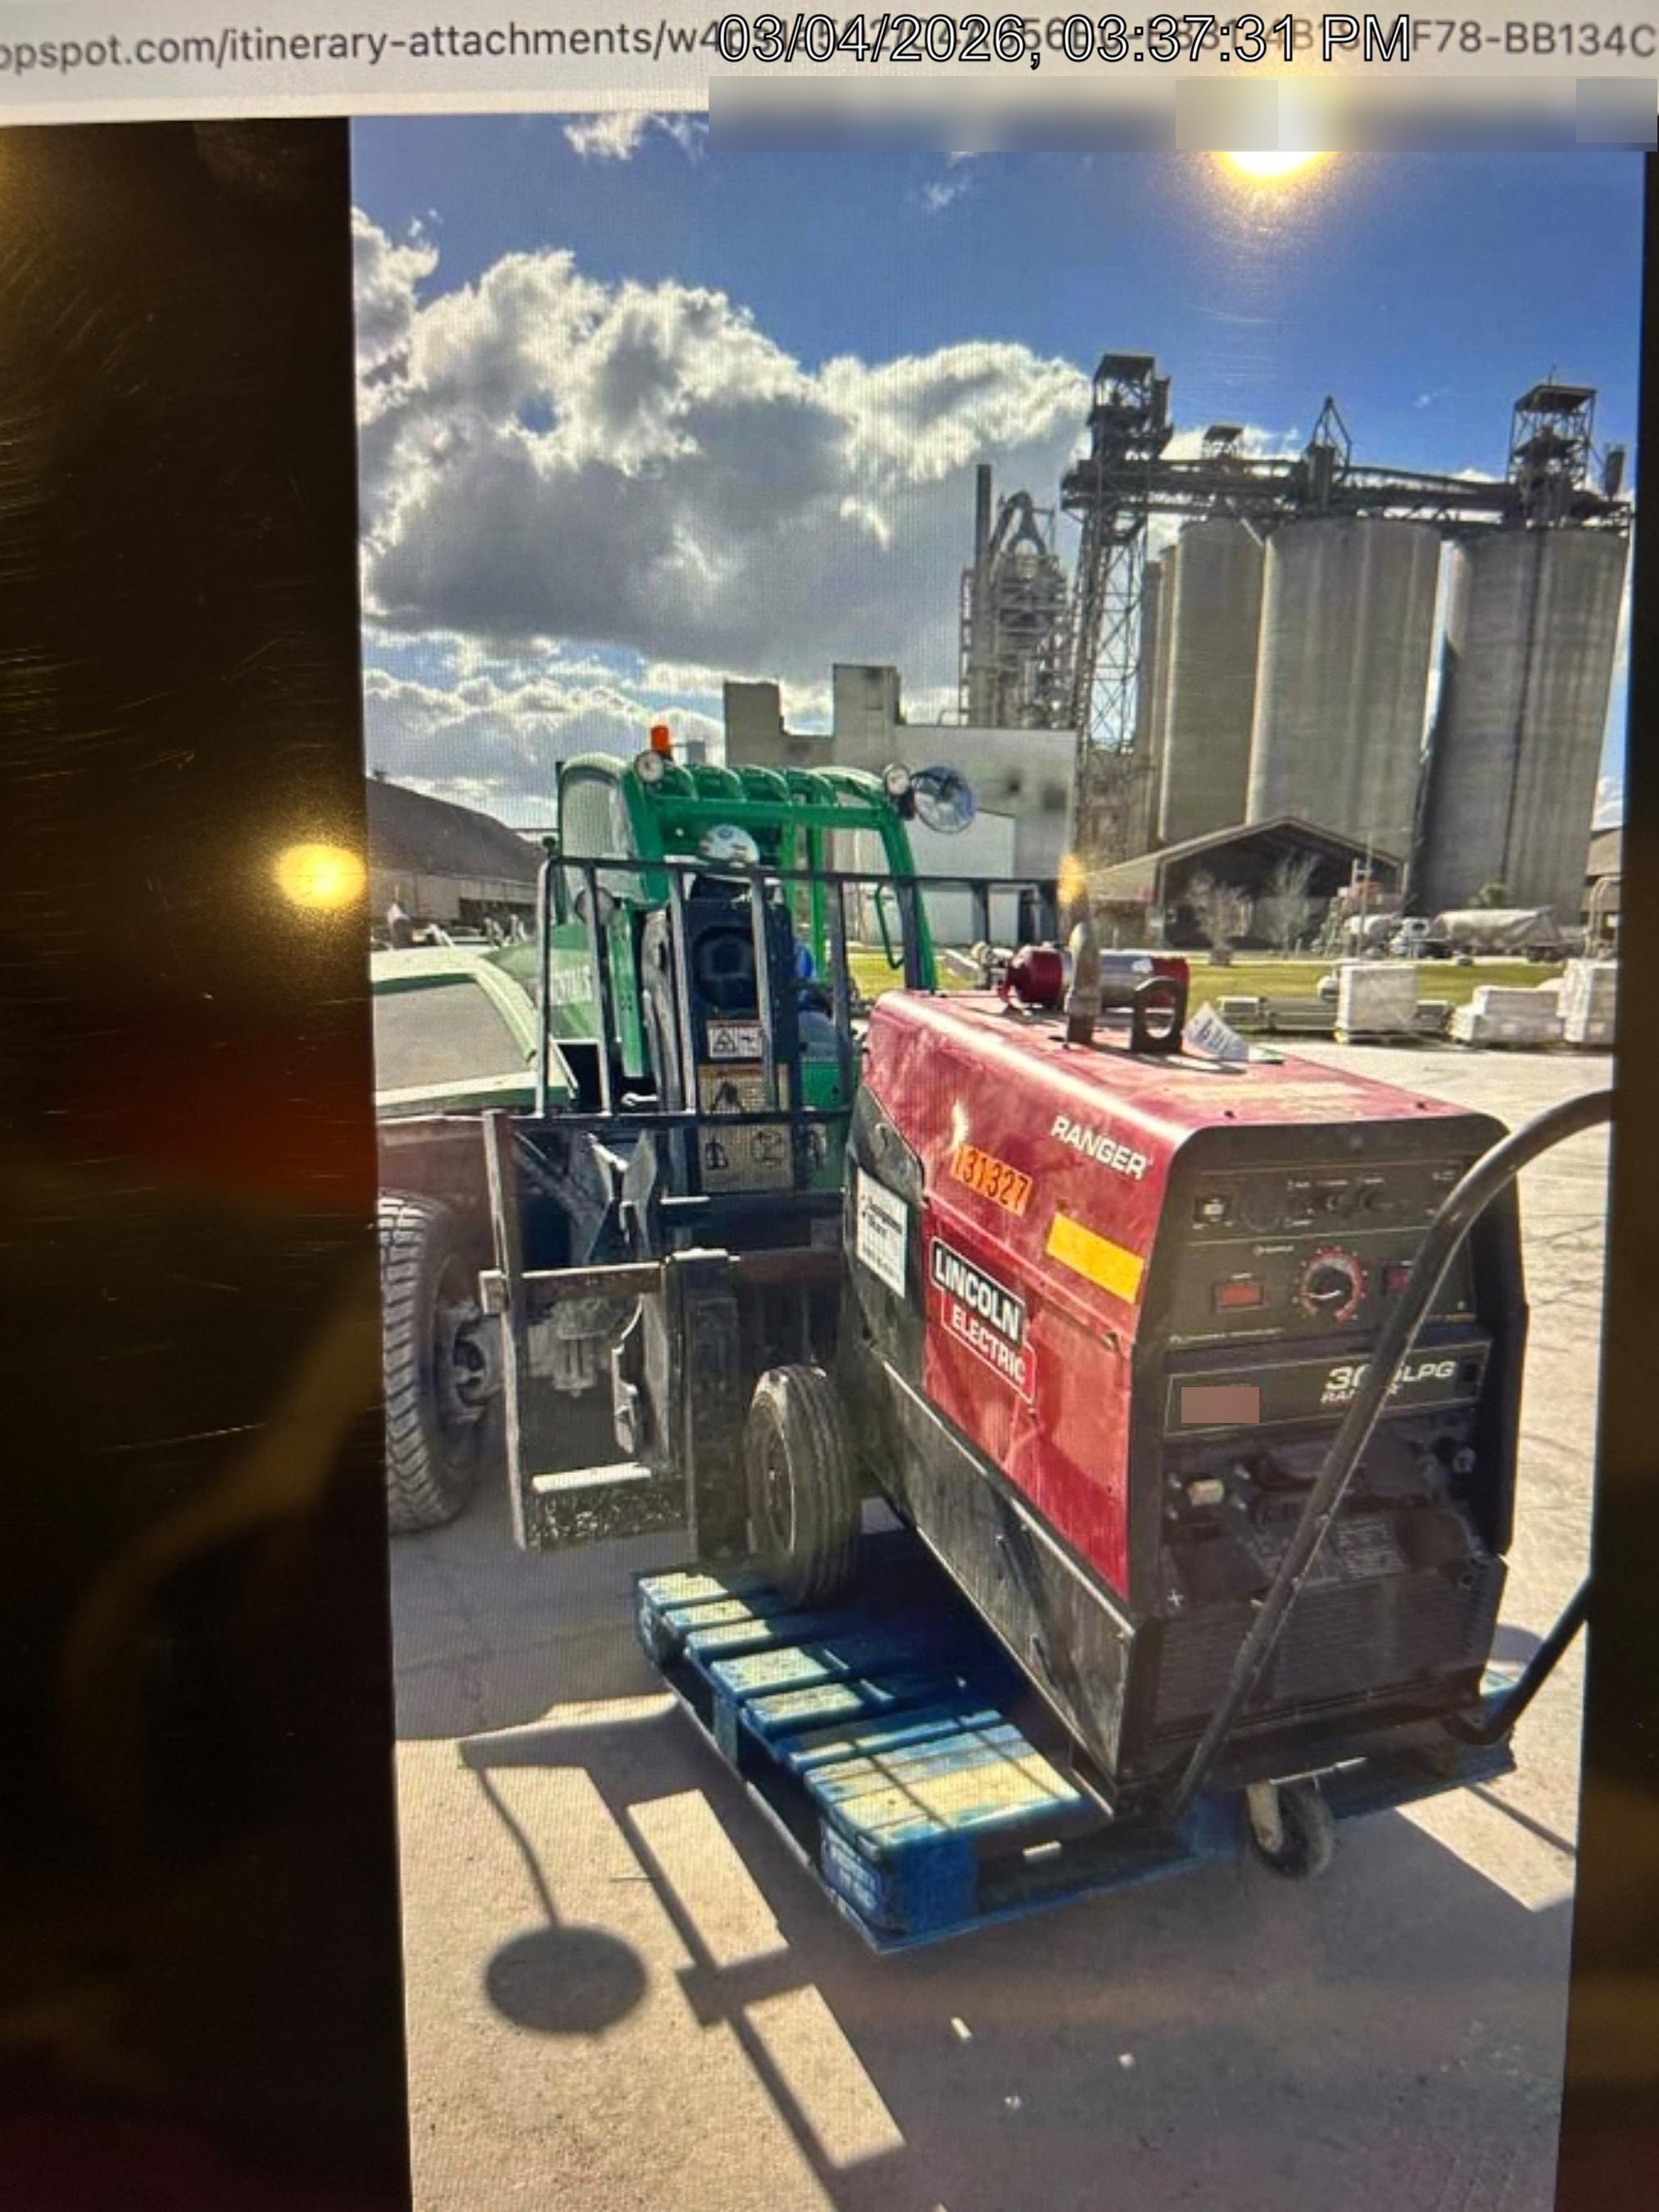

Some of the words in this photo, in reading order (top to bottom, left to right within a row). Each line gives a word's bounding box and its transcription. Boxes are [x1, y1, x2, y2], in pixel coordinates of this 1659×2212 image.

[954, 1145, 1030, 1210] 131327
[1050, 1114, 1148, 1181] RANGER
[935, 1247, 1019, 1342] LINCOLN
[952, 1304, 1026, 1385] ELECTRIC
[1403, 1360, 1456, 1382] LPG
